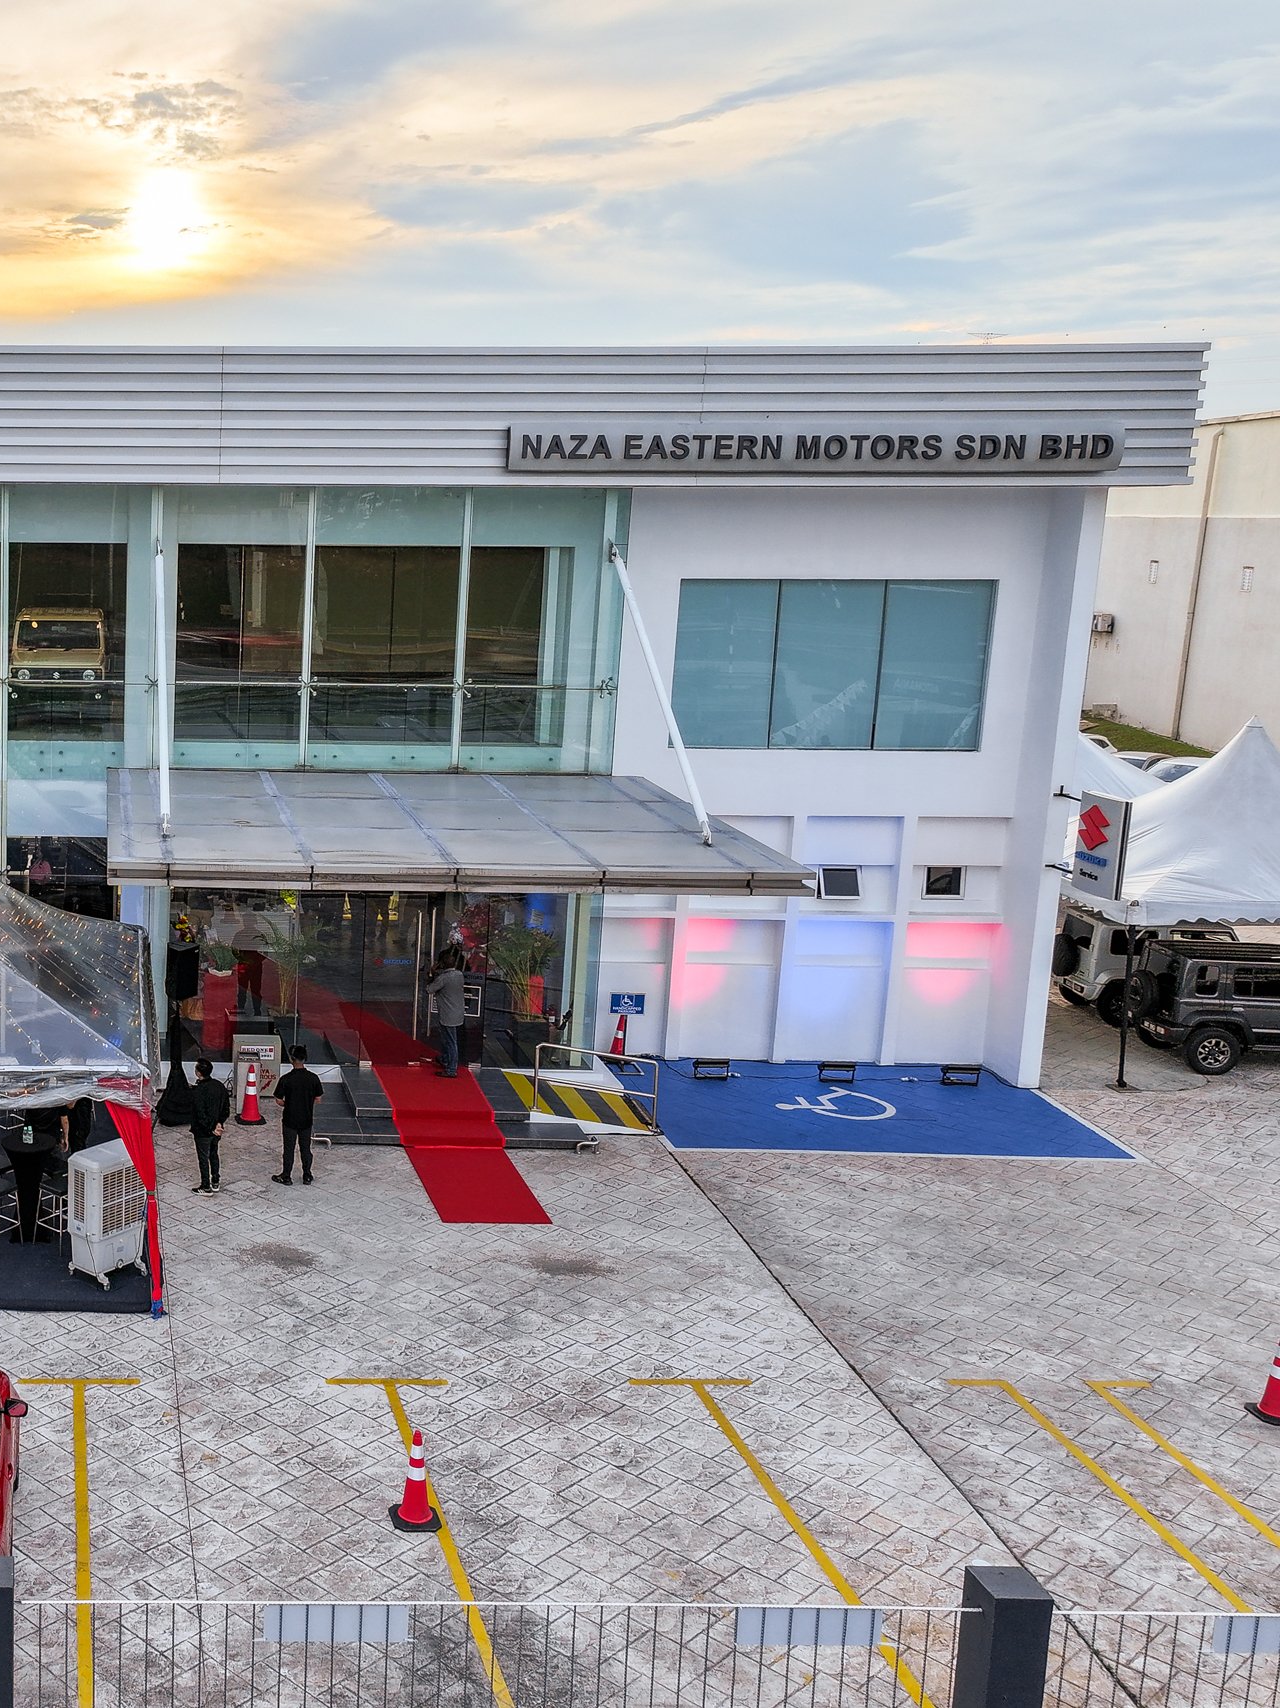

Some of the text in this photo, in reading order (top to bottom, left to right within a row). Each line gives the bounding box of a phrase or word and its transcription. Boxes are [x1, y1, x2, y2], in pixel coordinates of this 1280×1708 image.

[521, 434, 1115, 460] NAZA EASTERN MOTORS SDN BHD
